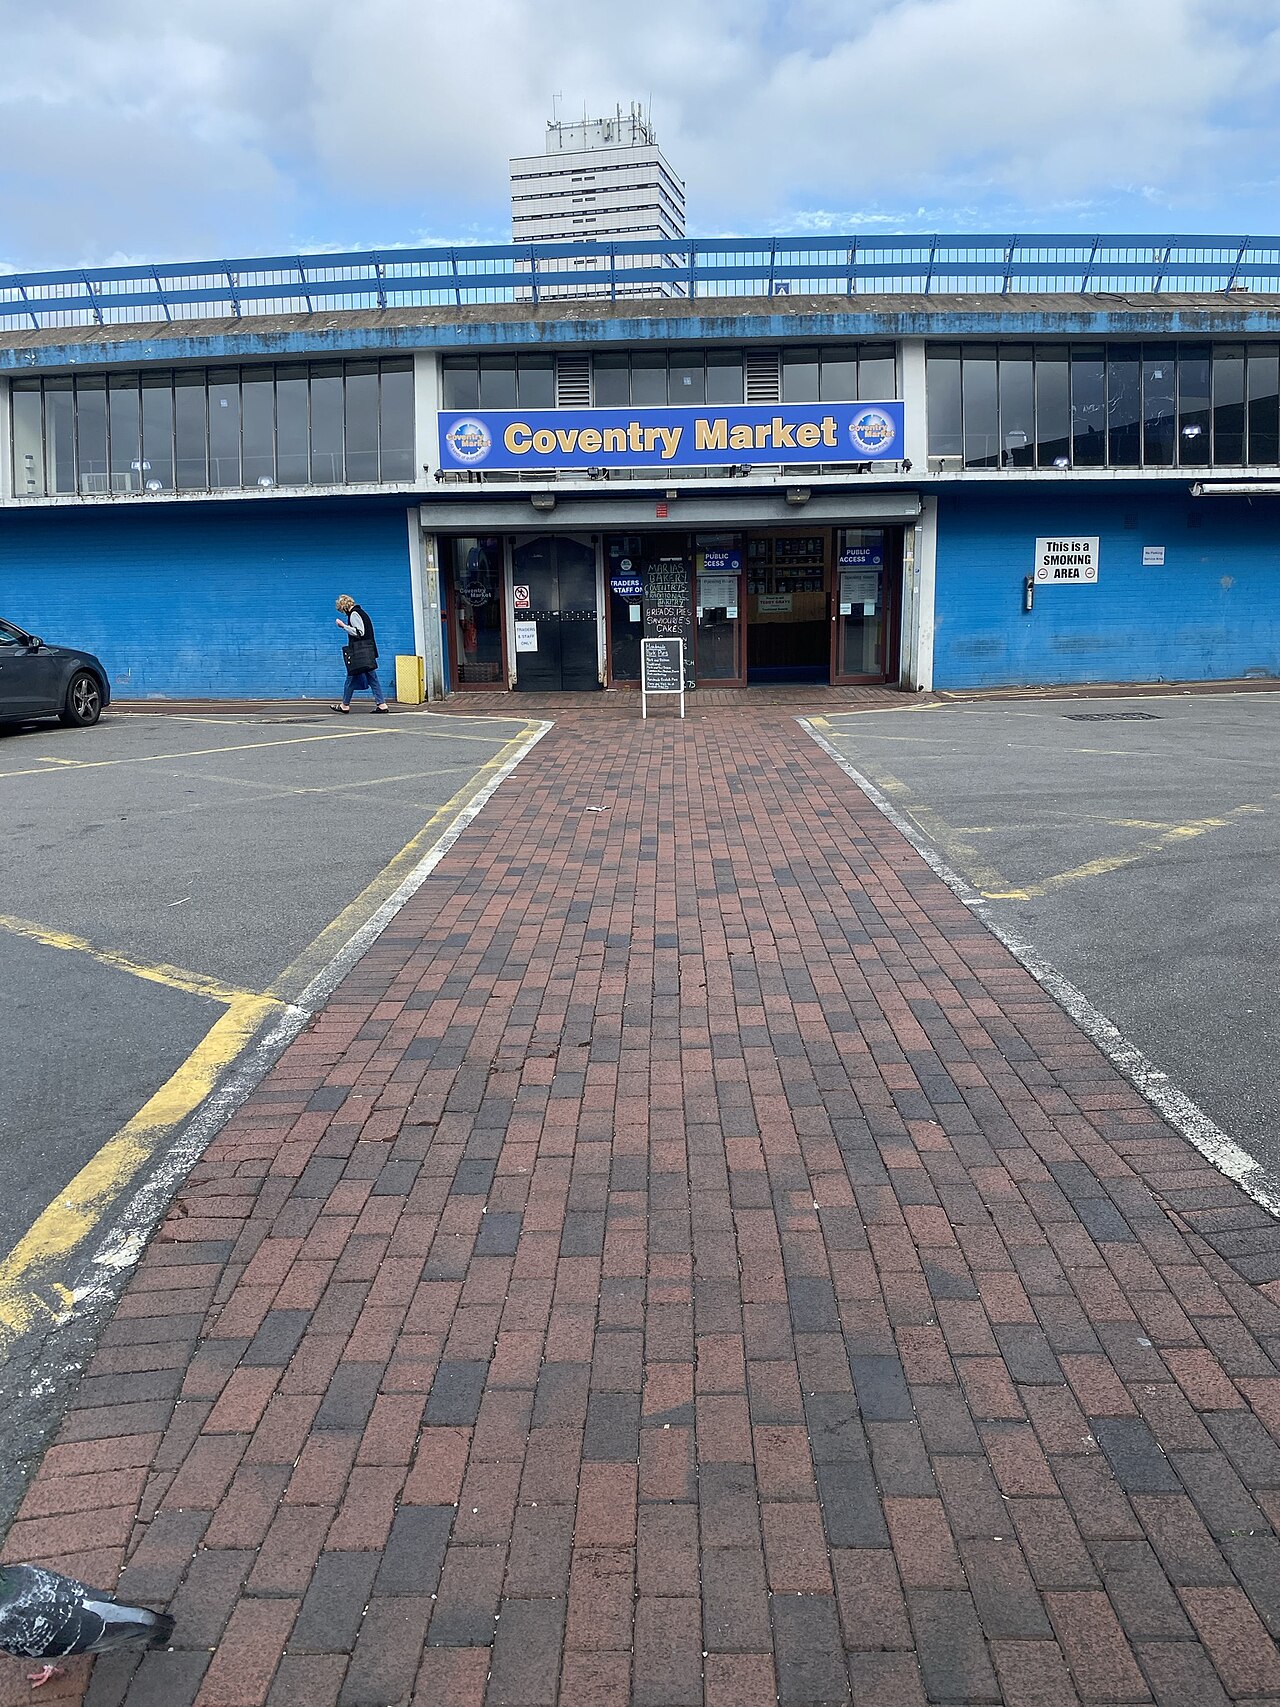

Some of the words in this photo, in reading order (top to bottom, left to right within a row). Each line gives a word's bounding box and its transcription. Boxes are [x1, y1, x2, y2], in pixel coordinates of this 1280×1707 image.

[849, 424, 888, 433] Coventry
[446, 433, 485, 442] Coventry
[503, 421, 683, 460] Coventry
[694, 415, 839, 451] Market
[865, 430, 895, 438] Market
[462, 439, 492, 447] Market
[1046, 541, 1069, 552] This
[1071, 541, 1081, 552] is
[1083, 543, 1090, 552] a
[1043, 554, 1092, 566] SMOKING
[1054, 568, 1080, 579] AREA
[650, 574, 687, 583] BAKERY
[656, 625, 683, 634] CAKES
